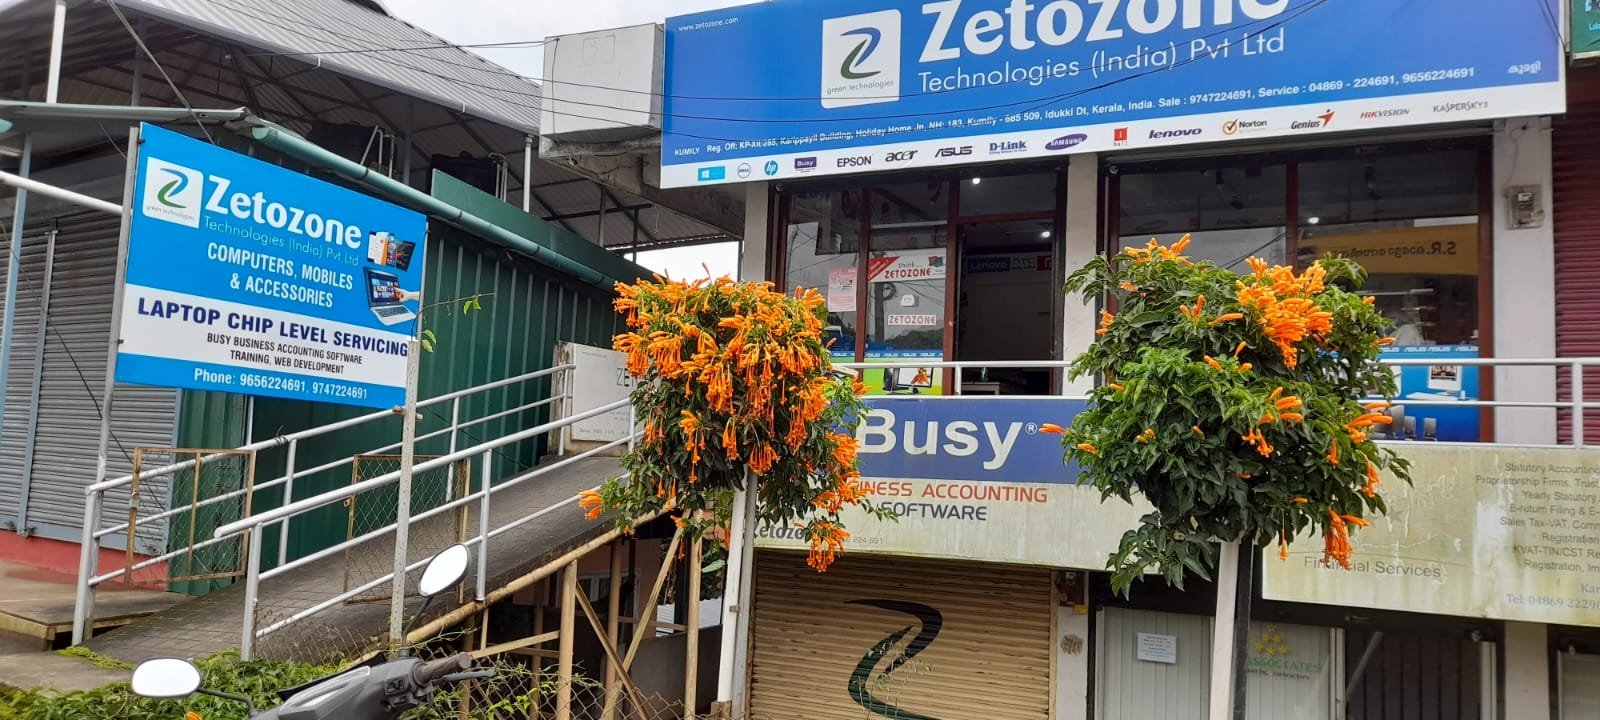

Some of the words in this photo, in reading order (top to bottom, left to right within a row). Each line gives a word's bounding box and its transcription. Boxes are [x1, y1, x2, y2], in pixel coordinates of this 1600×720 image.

[678, 16, 739, 32] www.zetozone.com
[918, 60, 1080, 93] Technologies
[1091, 41, 1176, 79] (India)
[1190, 37, 1229, 60] Pvt
[1243, 27, 1284, 56] Ltd
[827, 83, 847, 95] green
[848, 79, 895, 92] technologies
[706, 143, 721, 154] Reg.
[856, 125, 887, 139] Holiday
[888, 124, 912, 134] Home
[967, 115, 997, 129] Kumily
[1023, 109, 1043, 122] 509,
[1045, 106, 1074, 119] Idukki
[1076, 105, 1089, 117] Dt,
[1091, 101, 1126, 115] Kerala,
[1128, 99, 1155, 111] India.
[1158, 96, 1181, 108] Sale
[1189, 89, 1256, 105] 9747224691,
[1258, 85, 1300, 99] Service
[1309, 79, 1344, 93] 04869
[1353, 74, 1400, 89] 224691,
[1402, 66, 1476, 85] 9656224691
[1360, 108, 1410, 119] HIKVISION
[1238, 119, 1268, 129] Norton
[1291, 119, 1321, 130] Genius
[1148, 128, 1202, 140] lenovo
[674, 146, 700, 157] KUMILY
[935, 146, 973, 158] ASUS
[989, 140, 1028, 151] D-Link
[837, 155, 872, 167] EPSON
[885, 150, 918, 162] acer
[146, 205, 162, 213] green
[162, 207, 195, 221] technologies
[204, 174, 362, 249] Zetozone
[204, 215, 285, 247] Technologies
[288, 237, 323, 259] (India)
[326, 247, 342, 261] Pvt
[344, 256, 359, 266] Ltd
[207, 241, 298, 280] COMPUTERS,
[301, 263, 353, 291] MOBILES
[884, 267, 932, 279] ZETOZONE
[230, 272, 241, 289] &
[245, 275, 333, 308] ACCESSORIES
[138, 297, 221, 326] LAPTOP
[227, 312, 274, 334] CHIP
[280, 320, 328, 344] LEVEL
[333, 330, 408, 357] SERVICING
[888, 314, 936, 325] ZETOZONE
[207, 332, 232, 346] BUSY
[234, 336, 275, 352] BUSINESS
[277, 341, 325, 359] ACCOUNTING
[326, 350, 363, 365] SOFTWARE
[230, 349, 272, 366] TRAINING,
[274, 356, 292, 368] WEB
[293, 358, 345, 374] DEVELOPMENT
[194, 367, 236, 385] Phone:
[240, 373, 309, 393] 9656224691,
[312, 382, 368, 399] 9747224691
[1504, 462, 1546, 475] Statutory
[922, 483, 1048, 503] ACCOUNTING
[1522, 490, 1551, 502] Yearly
[1554, 491, 1597, 504] Statutory
[1510, 503, 1548, 514] E-return
[1550, 504, 1576, 517] Filing
[1579, 507, 1586, 516] &
[1500, 516, 1526, 527] Sales
[1375, 560, 1442, 578] Services
